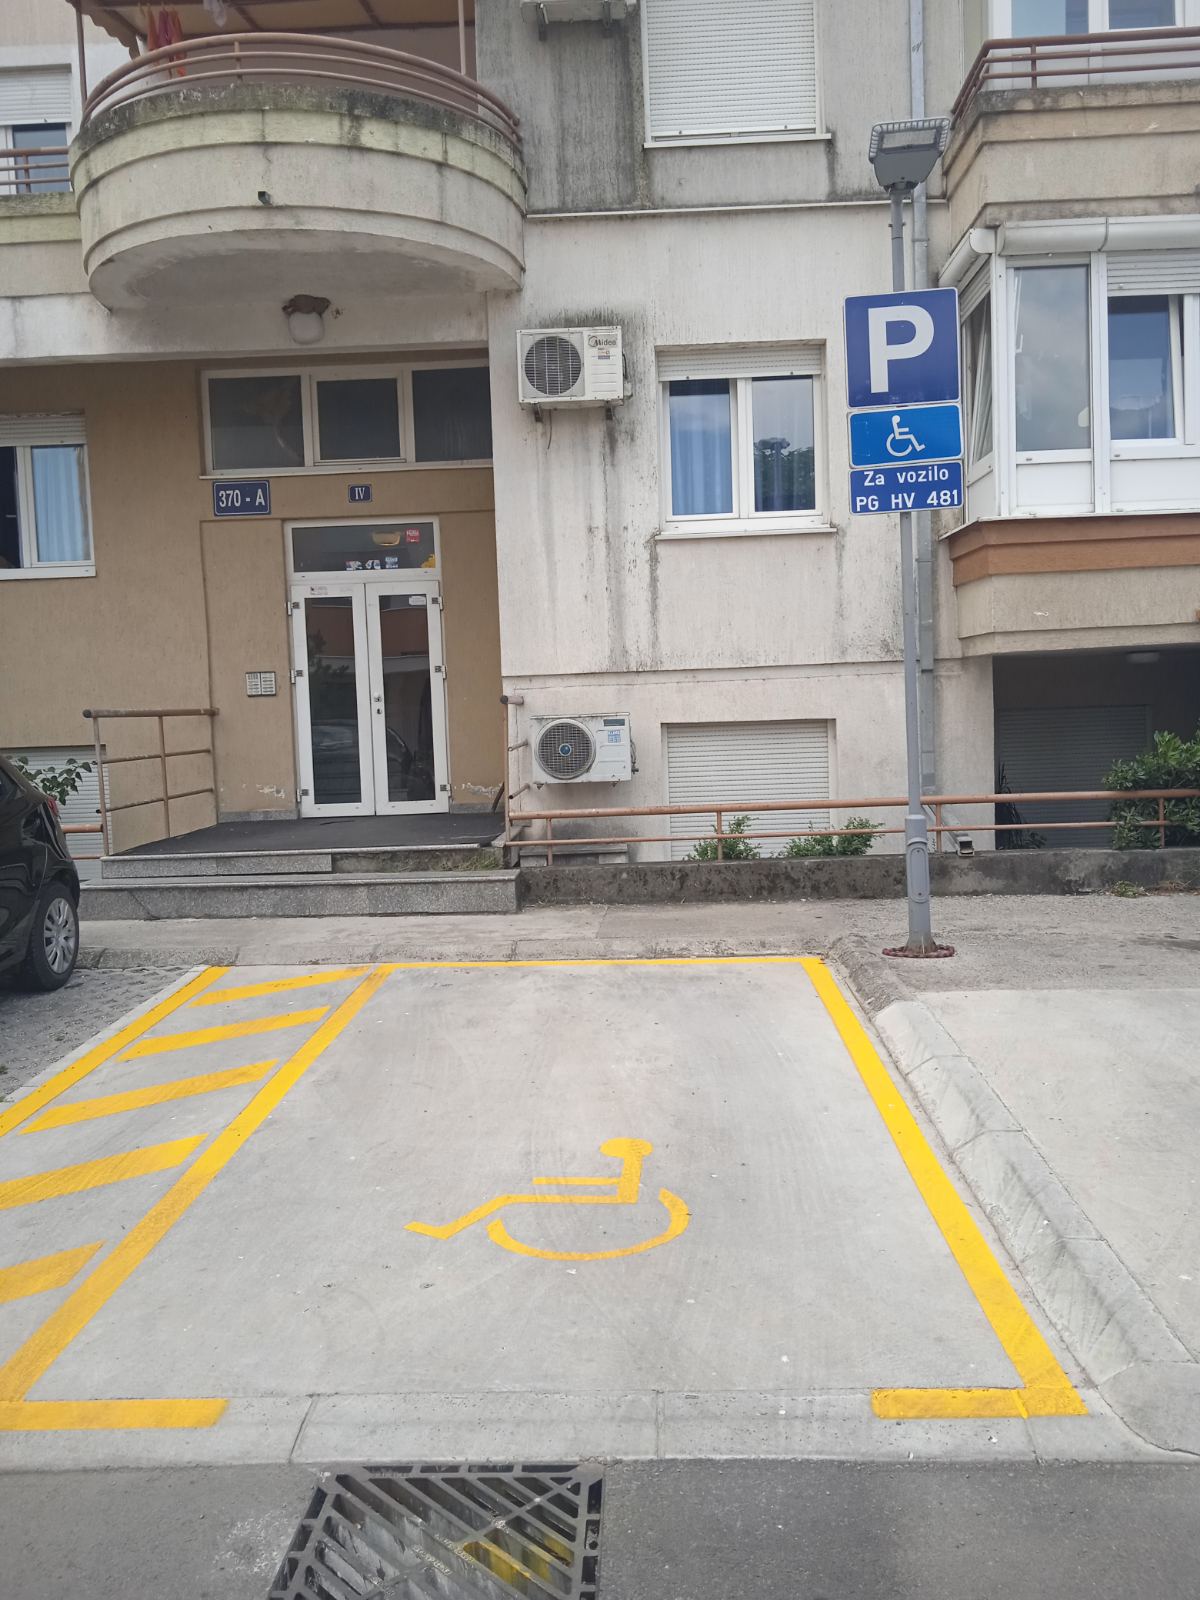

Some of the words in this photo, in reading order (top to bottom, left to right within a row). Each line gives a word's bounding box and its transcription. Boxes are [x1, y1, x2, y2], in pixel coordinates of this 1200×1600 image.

[868, 305, 934, 394] P
[864, 471, 885, 486] Za
[897, 465, 949, 483] vozilo
[219, 489, 241, 508] 370
[255, 489, 266, 506] A
[354, 487, 366, 500] IV
[856, 495, 879, 512] PG
[891, 492, 916, 509] HV
[927, 489, 958, 506] 481
